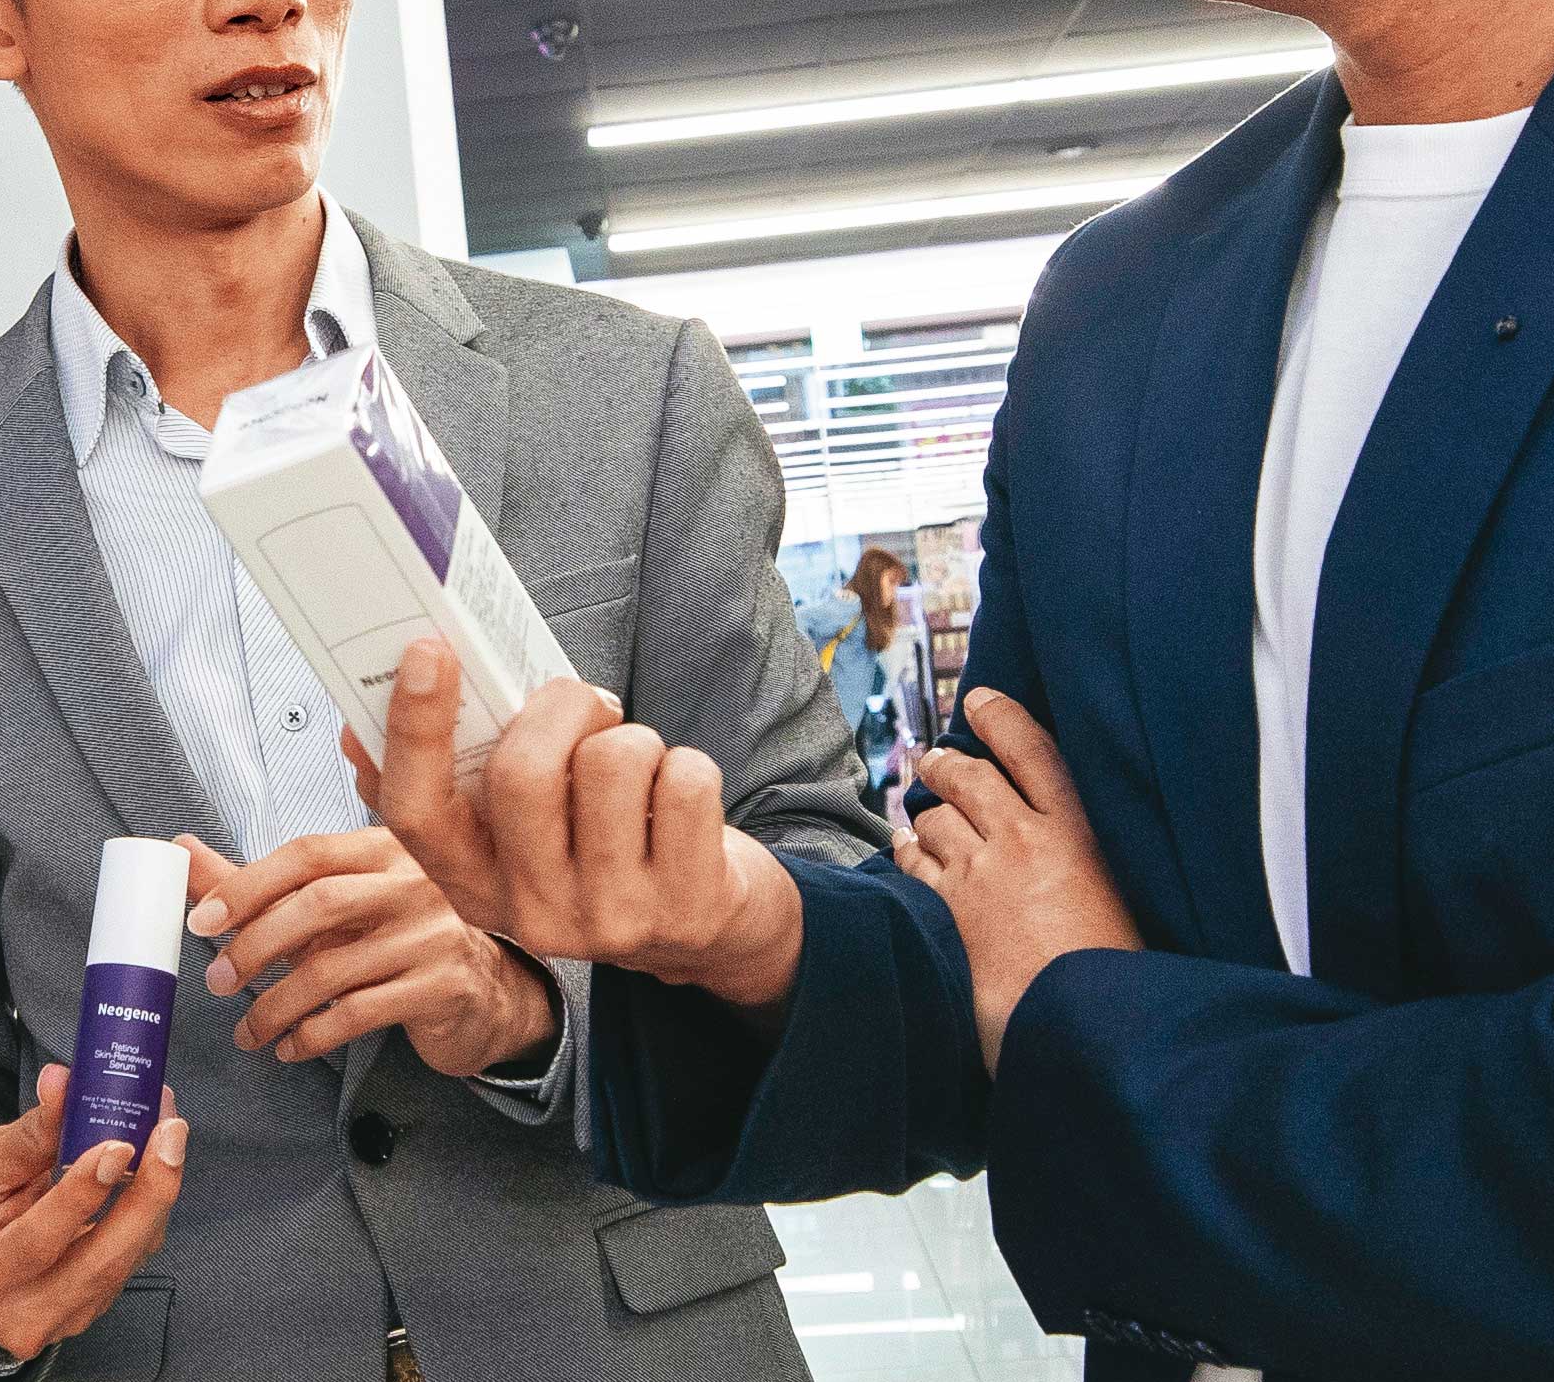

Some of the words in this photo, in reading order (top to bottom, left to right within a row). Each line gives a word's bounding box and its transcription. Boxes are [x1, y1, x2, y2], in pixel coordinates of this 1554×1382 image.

[97, 1002, 161, 1025] Neogence
[110, 1041, 140, 1055] Retinol
[93, 1049, 153, 1069] Skin-Renewing
[108, 1059, 137, 1074] Serum
